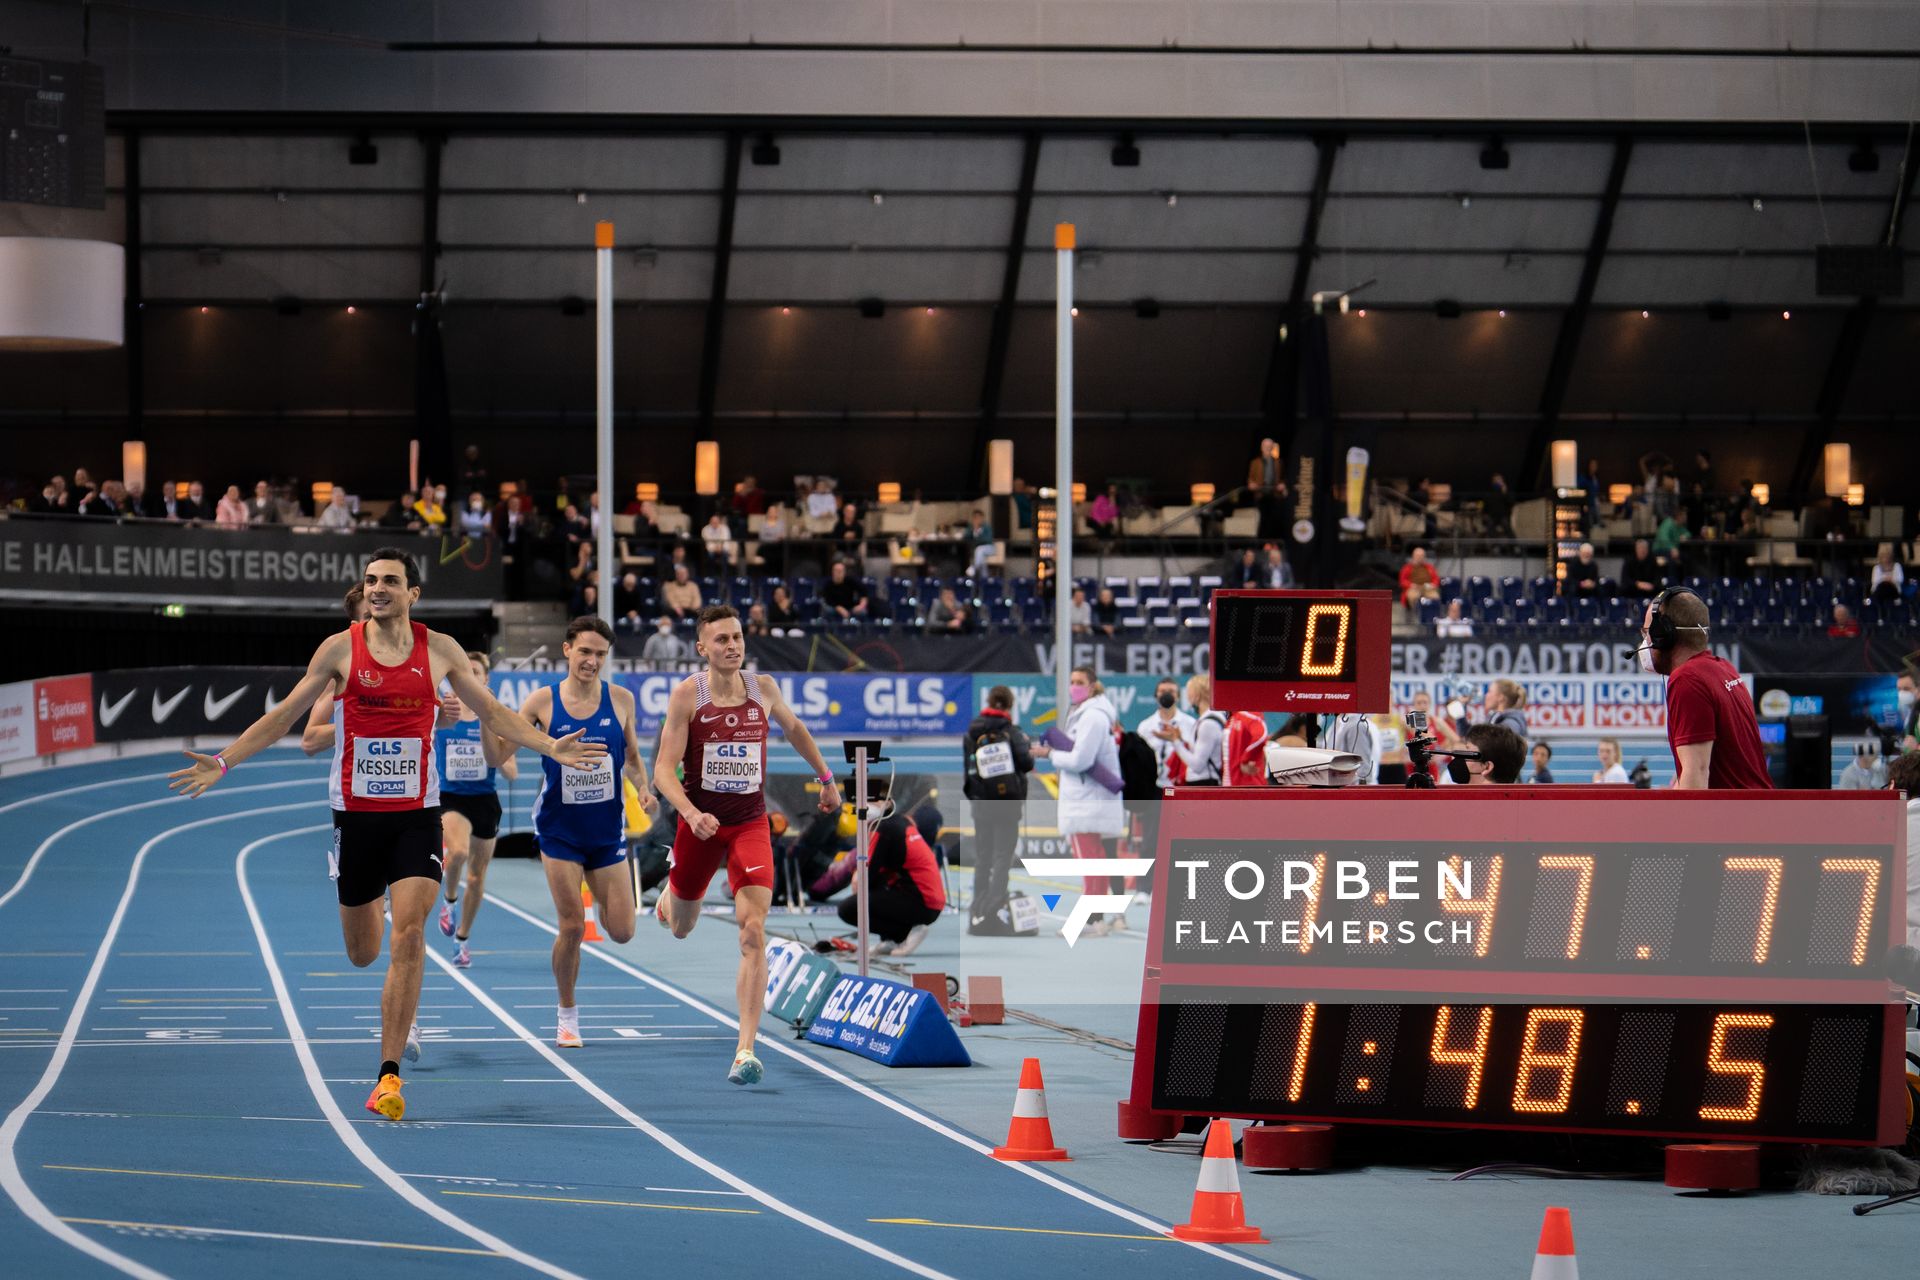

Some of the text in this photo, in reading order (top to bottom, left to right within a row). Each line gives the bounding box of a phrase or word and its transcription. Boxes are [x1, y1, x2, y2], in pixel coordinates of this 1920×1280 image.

[1300, 605, 1350, 675] 0
[1035, 643, 1115, 676] VEL
[1595, 682, 1664, 704] LIQUI
[1595, 705, 1664, 725] MOLY
[357, 759, 416, 775] KESSLER
[706, 761, 759, 777] BEBENDORF
[565, 771, 612, 787] SCHWARZER
[1288, 1001, 1775, 1121] 1:48.5
